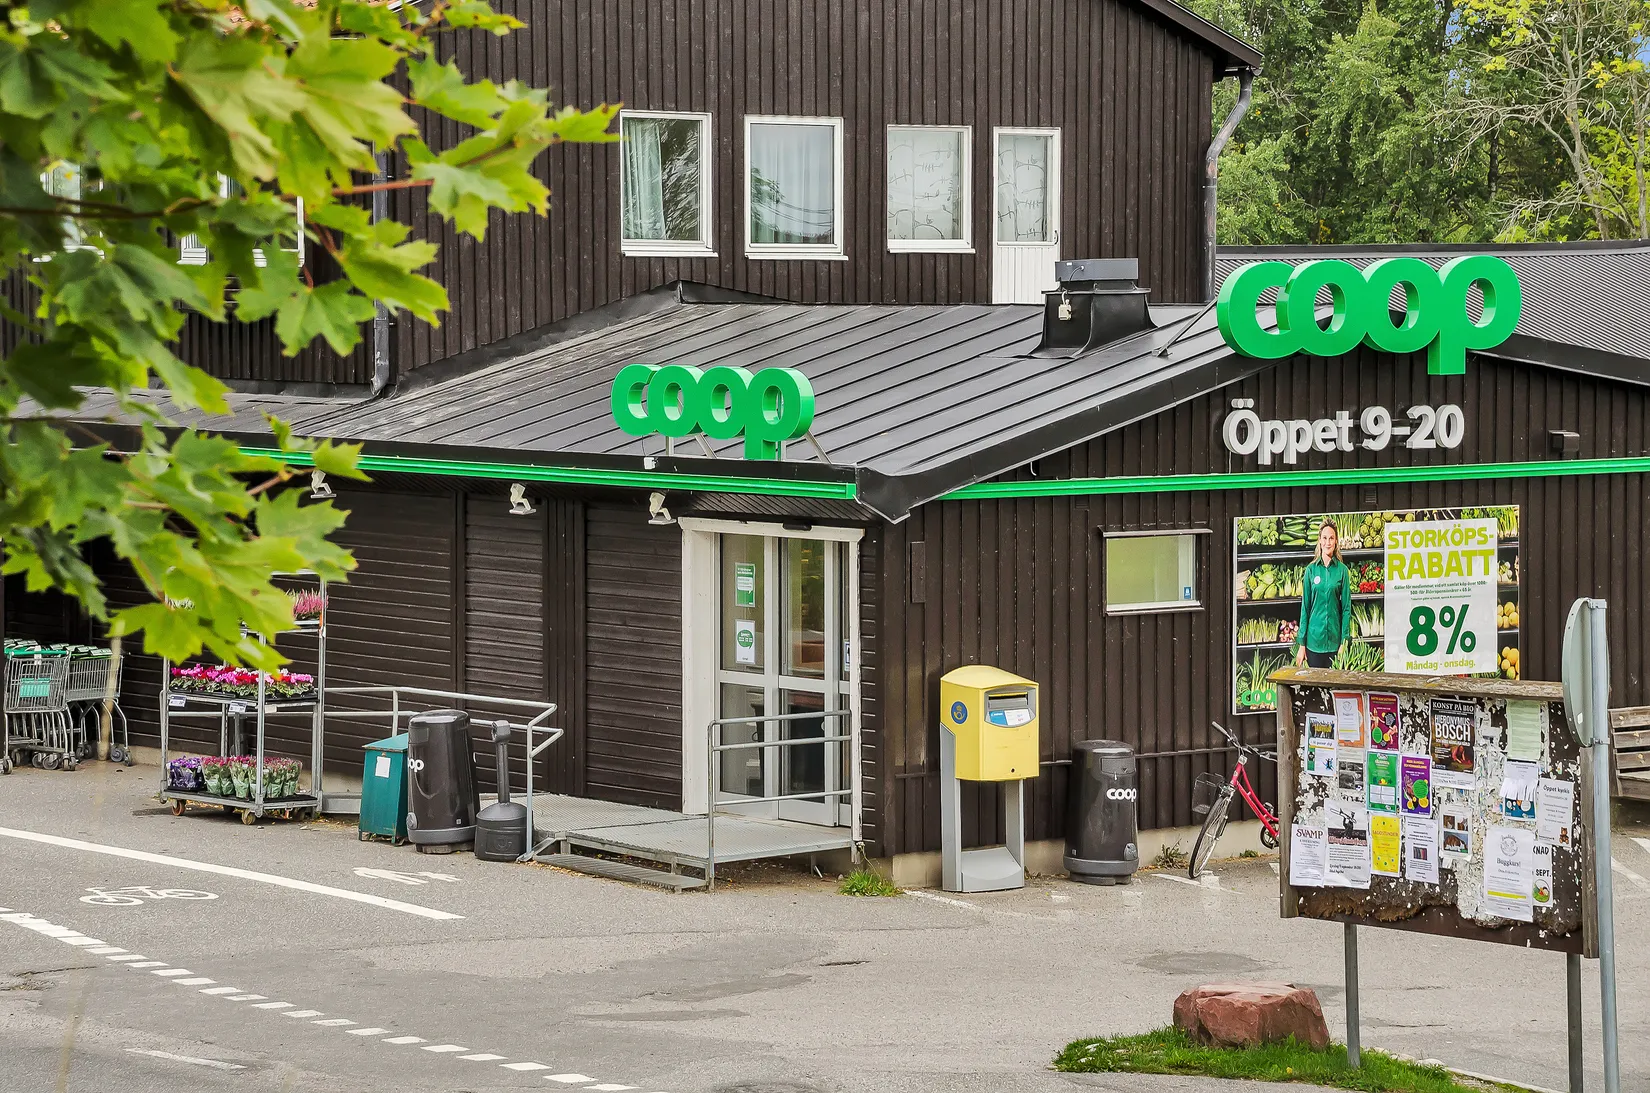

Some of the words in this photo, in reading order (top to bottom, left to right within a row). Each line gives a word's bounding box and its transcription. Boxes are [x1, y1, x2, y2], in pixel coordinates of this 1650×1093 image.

[1216, 254, 1522, 375] coop
[611, 363, 815, 461] coop
[1222, 398, 1354, 466] Öppet
[1360, 404, 1465, 452] 9-20
[1387, 523, 1494, 550] STORKÖPS-
[1387, 548, 1495, 581] RABATT
[1406, 604, 1476, 656] 8%
[1406, 660, 1438, 670] Måndag
[1444, 658, 1476, 668] onsdag.
[1432, 701, 1453, 709] KONST
[1454, 702, 1462, 711] PÅ
[1434, 714, 1471, 726] HIERONYMUS
[1435, 722, 1471, 742] BOSCH
[1106, 788, 1136, 802] coop
[1296, 828, 1323, 839] SVAMP
[1536, 868, 1551, 877] SEPT.
